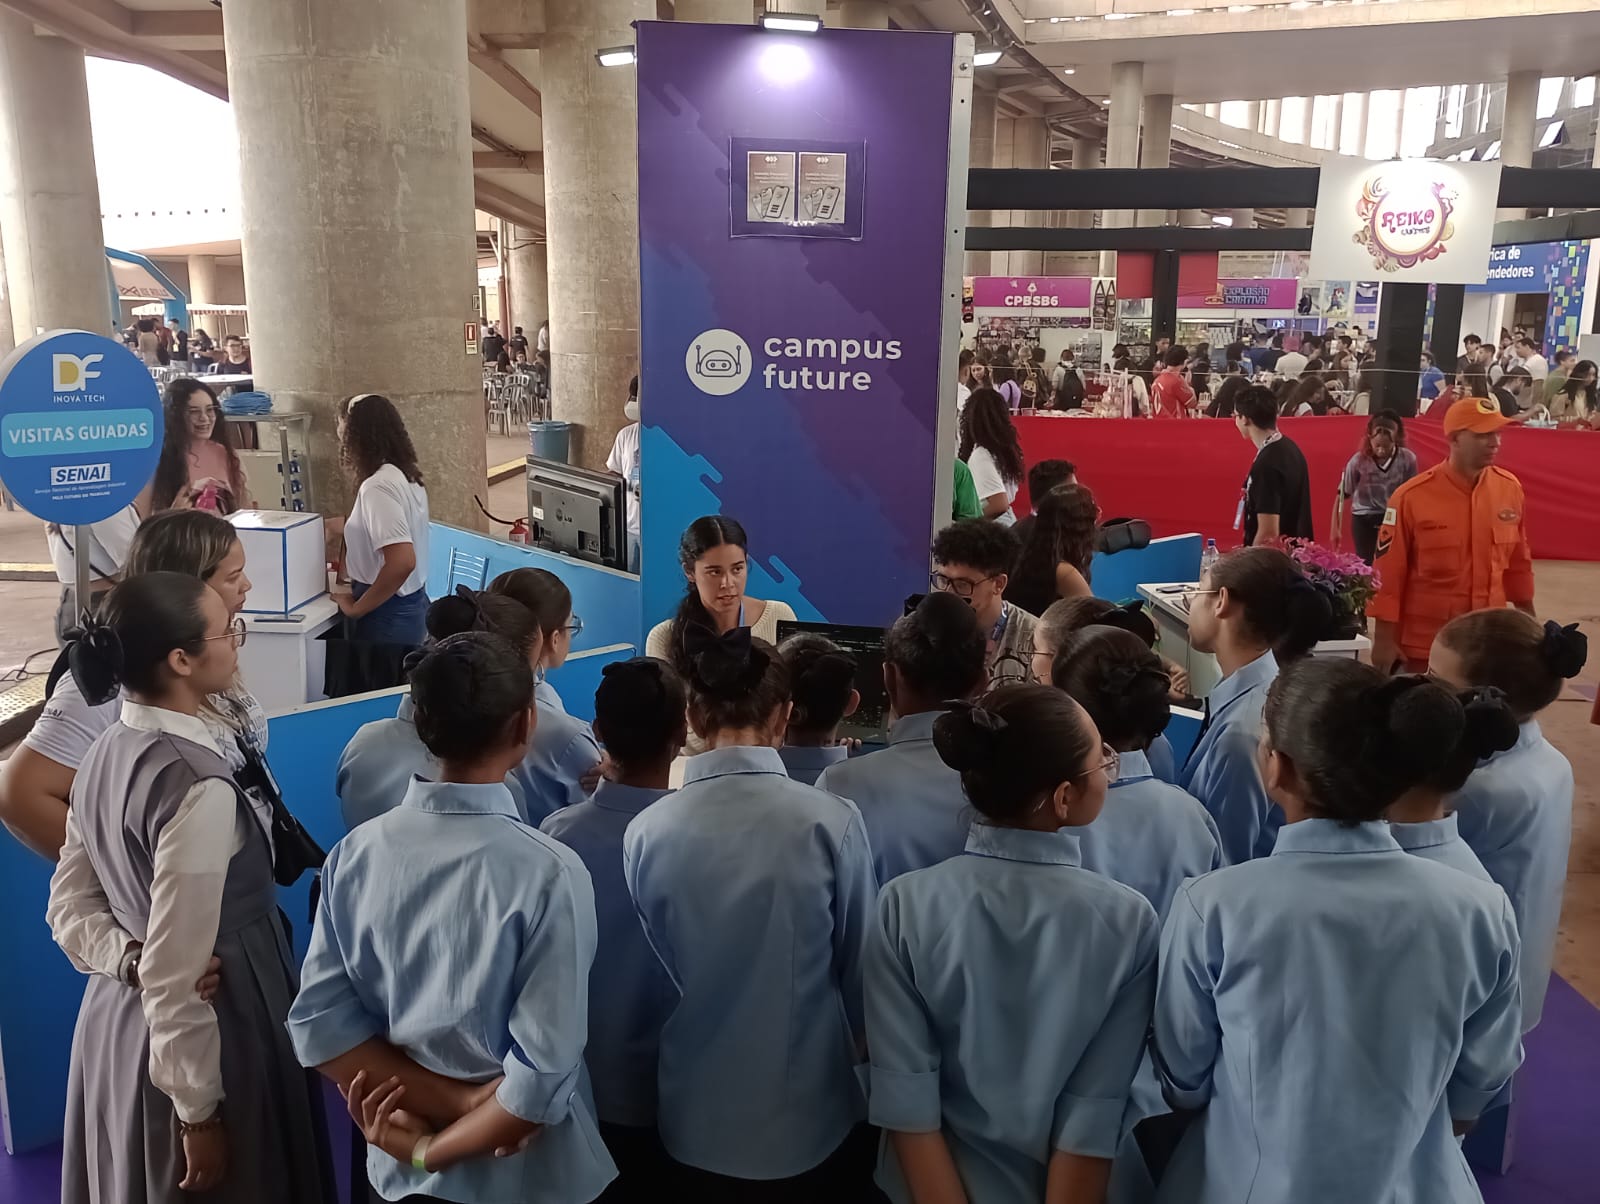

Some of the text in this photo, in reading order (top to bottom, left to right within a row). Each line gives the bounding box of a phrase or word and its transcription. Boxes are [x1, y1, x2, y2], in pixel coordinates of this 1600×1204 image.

[1381, 209, 1435, 233] REIKO
[1508, 245, 1521, 260] de
[1487, 264, 1535, 279] ndedores
[1004, 295, 1059, 307] CPBSB6
[763, 336, 903, 365] campus
[762, 363, 872, 391] future
[53, 394, 105, 404] INOVA TECH
[8, 422, 148, 445] VISITAS GUIADAS
[55, 466, 106, 483] SENAI
